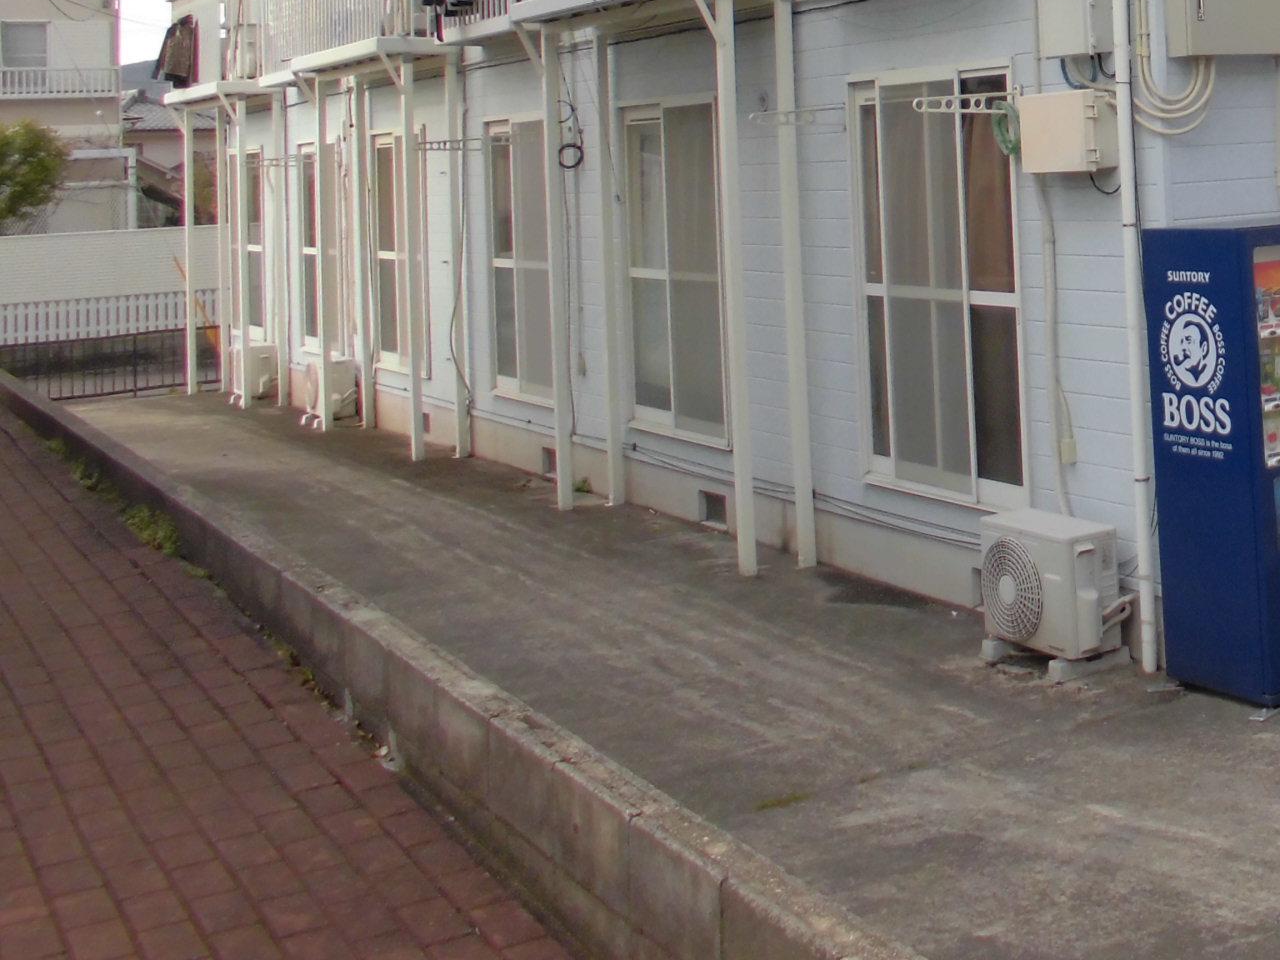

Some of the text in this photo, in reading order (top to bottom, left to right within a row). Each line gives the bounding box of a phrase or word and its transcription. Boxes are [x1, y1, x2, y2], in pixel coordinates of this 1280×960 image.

[1167, 270, 1211, 283] SUNTORY
[1165, 292, 1217, 323] COFFEE
[1160, 320, 1181, 391] BOSS COFFEE
[1207, 323, 1226, 394] BOSS COFFEE
[1162, 392, 1232, 435] BOSS
